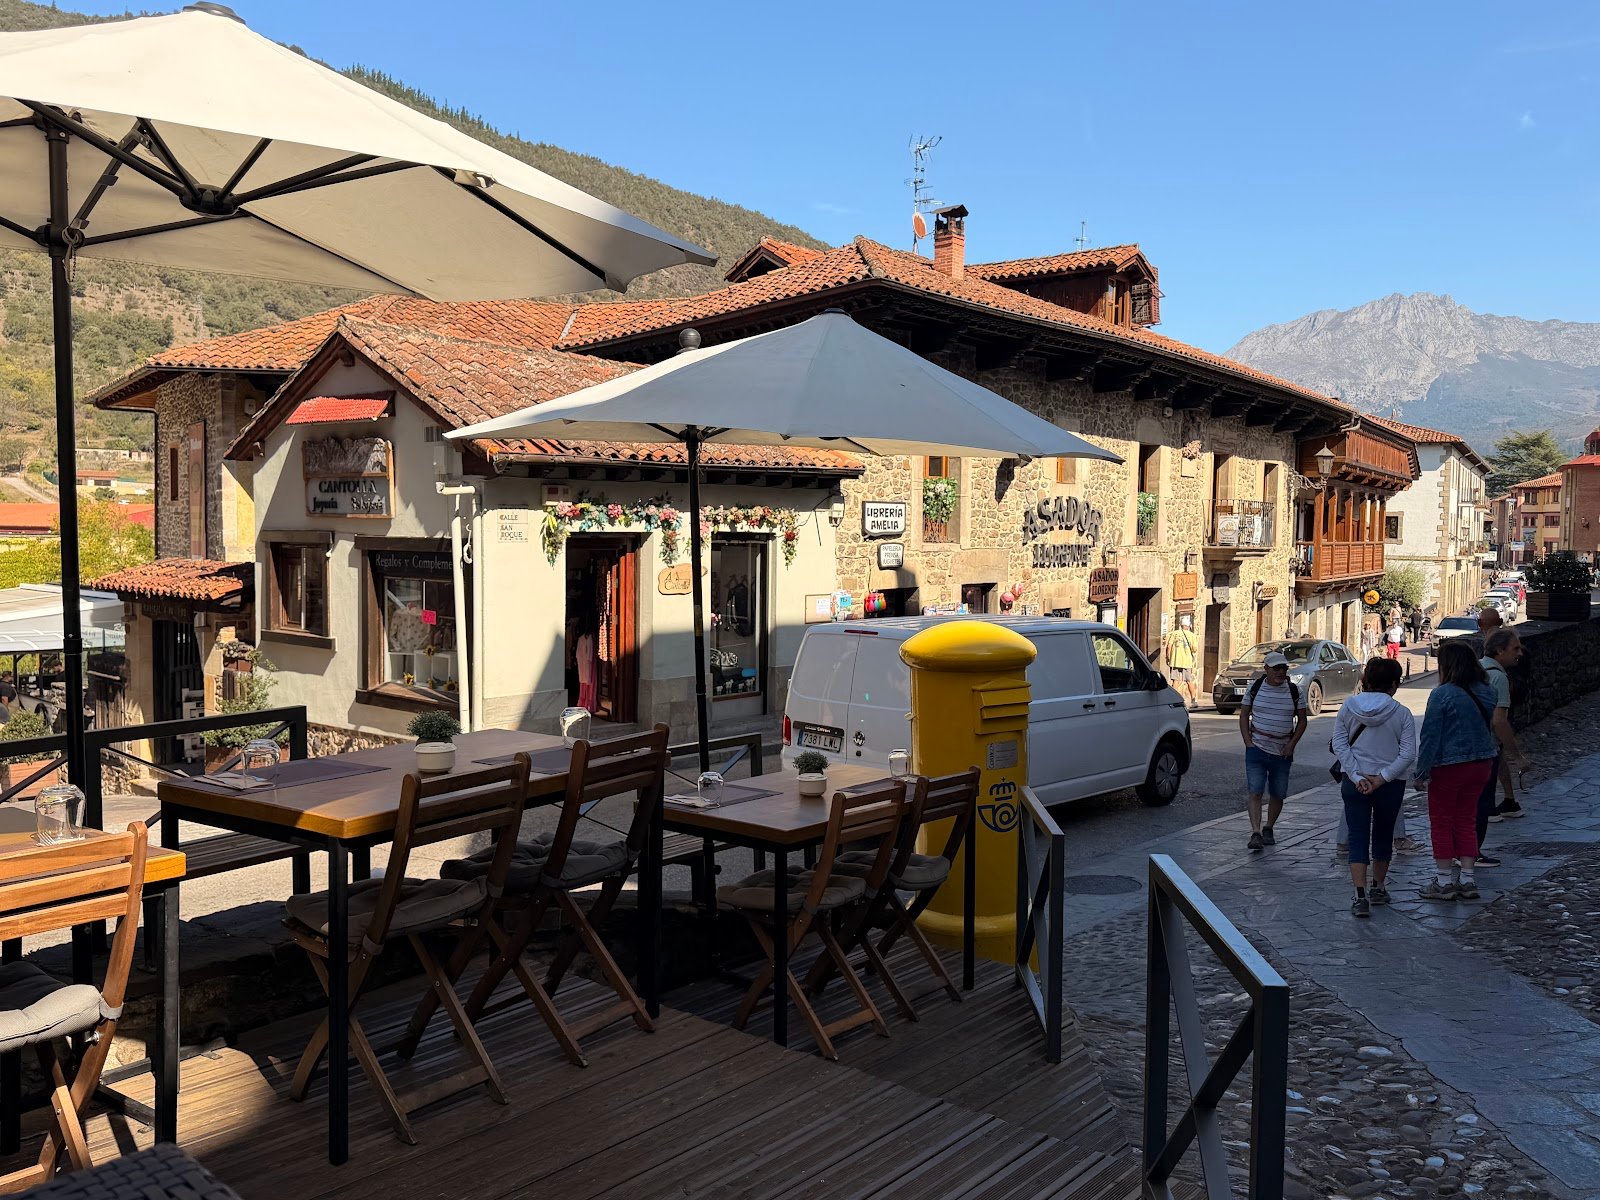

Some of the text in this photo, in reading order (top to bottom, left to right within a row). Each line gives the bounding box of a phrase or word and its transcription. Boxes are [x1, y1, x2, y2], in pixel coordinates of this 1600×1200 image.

[318, 480, 378, 494] CANTOLLA
[866, 505, 904, 518] LIBRERÍA
[870, 519, 900, 531] AMELIA
[1022, 495, 1104, 547] ASADOR
[500, 531, 523, 539] ROQUE
[375, 553, 402, 567] Regalos
[412, 554, 453, 573] Compleme
[1092, 569, 1119, 583] ASADOR
[1091, 584, 1118, 596] LLORENTE
